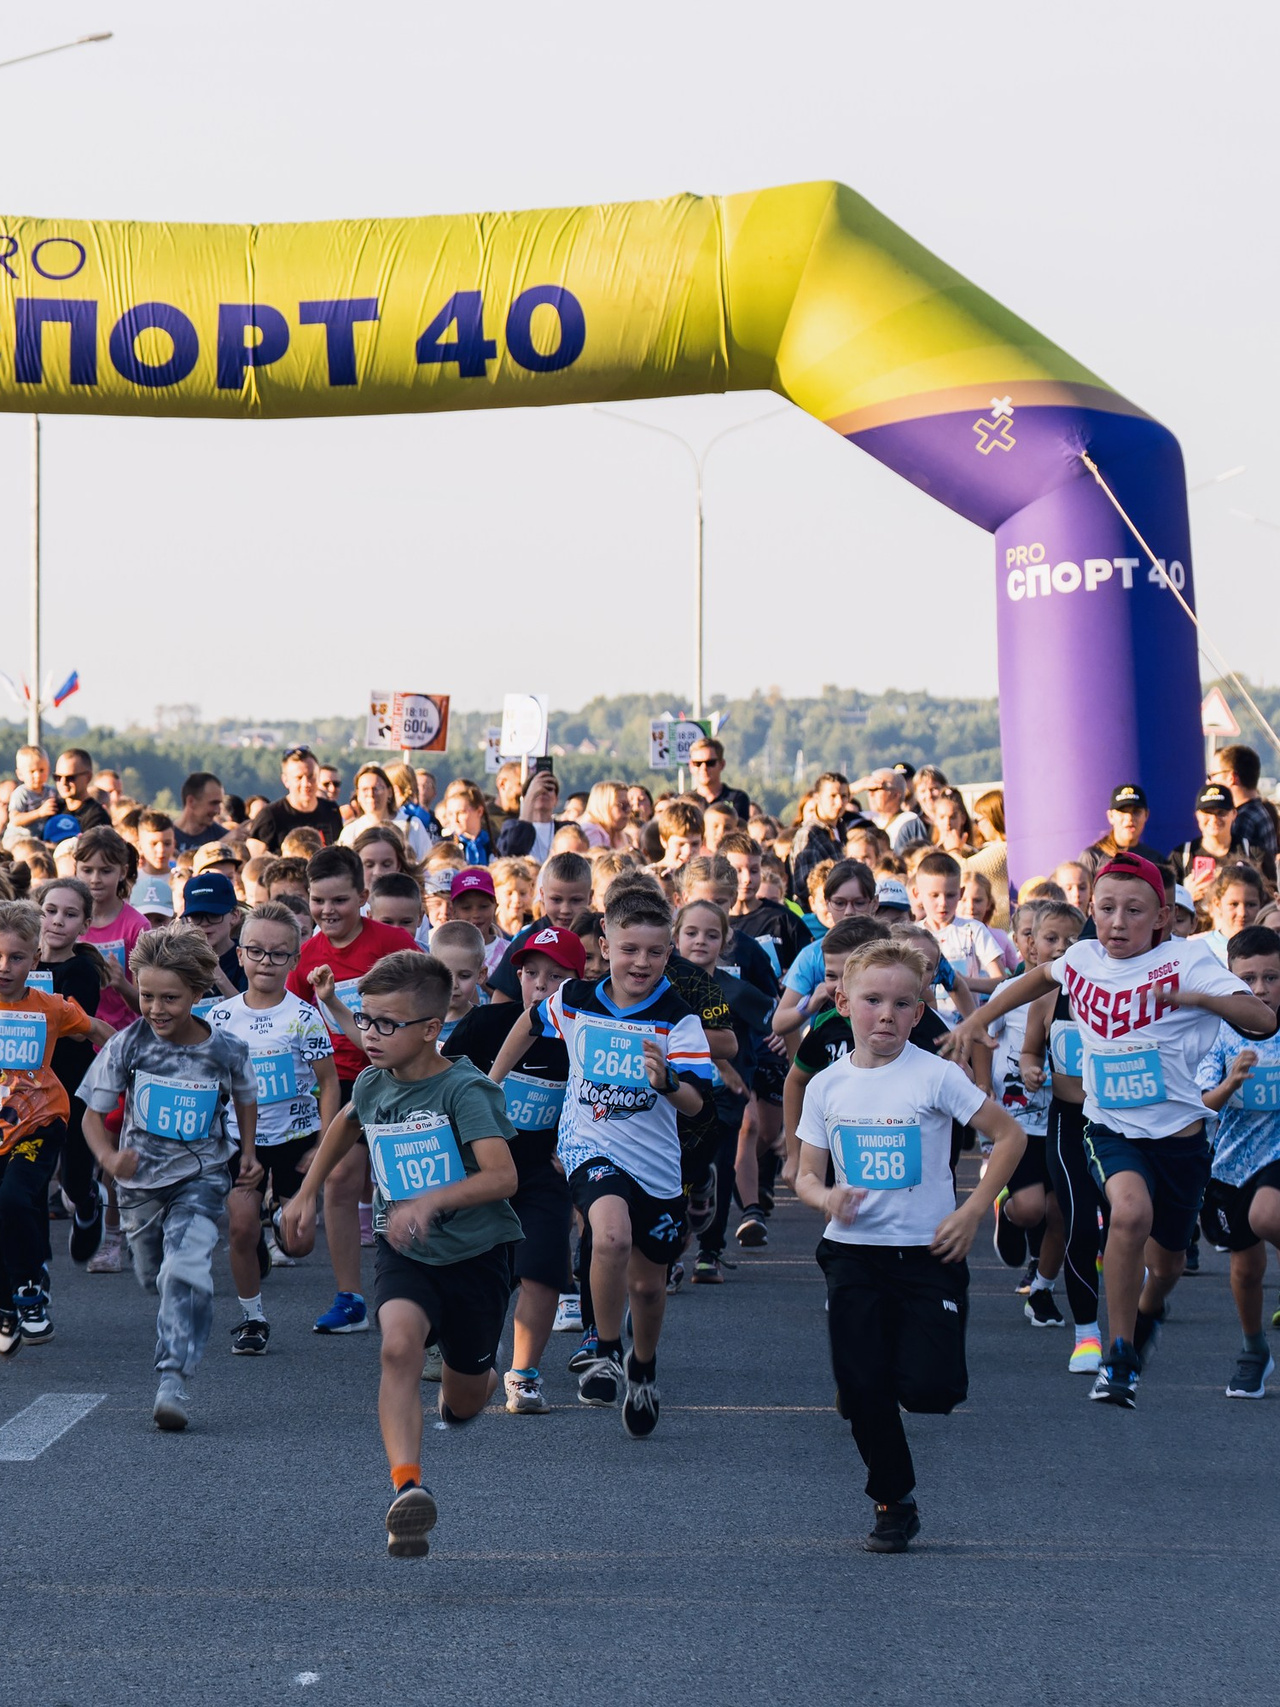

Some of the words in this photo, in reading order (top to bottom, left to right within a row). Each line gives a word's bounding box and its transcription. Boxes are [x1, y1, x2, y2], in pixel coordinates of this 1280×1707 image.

[414, 284, 587, 380] 40
[1006, 542, 1046, 570] PRO
[1006, 557, 1140, 602] СПОРТ
[1147, 557, 1186, 592] 40
[677, 741, 692, 753] 60
[1147, 962, 1173, 981] BOSCO
[1064, 961, 1180, 1040] RUSSIA
[610, 1036, 632, 1050] ЕГОР
[592, 1049, 646, 1080] 2643
[1102, 1057, 1147, 1074] НИКОЛАЙ
[526, 1090, 550, 1103] ИВАН
[1103, 1072, 1158, 1101] 4455
[1254, 1083, 1280, 1105] 31
[173, 1095, 197, 1108] ГЛЕБ
[506, 1099, 557, 1126] 3518
[157, 1105, 208, 1135] 5181
[393, 1135, 441, 1158] ДМИТРИЙ
[856, 1132, 906, 1148] ТИМОФЕЙ
[395, 1152, 451, 1191] 1927
[860, 1151, 907, 1181] 258
